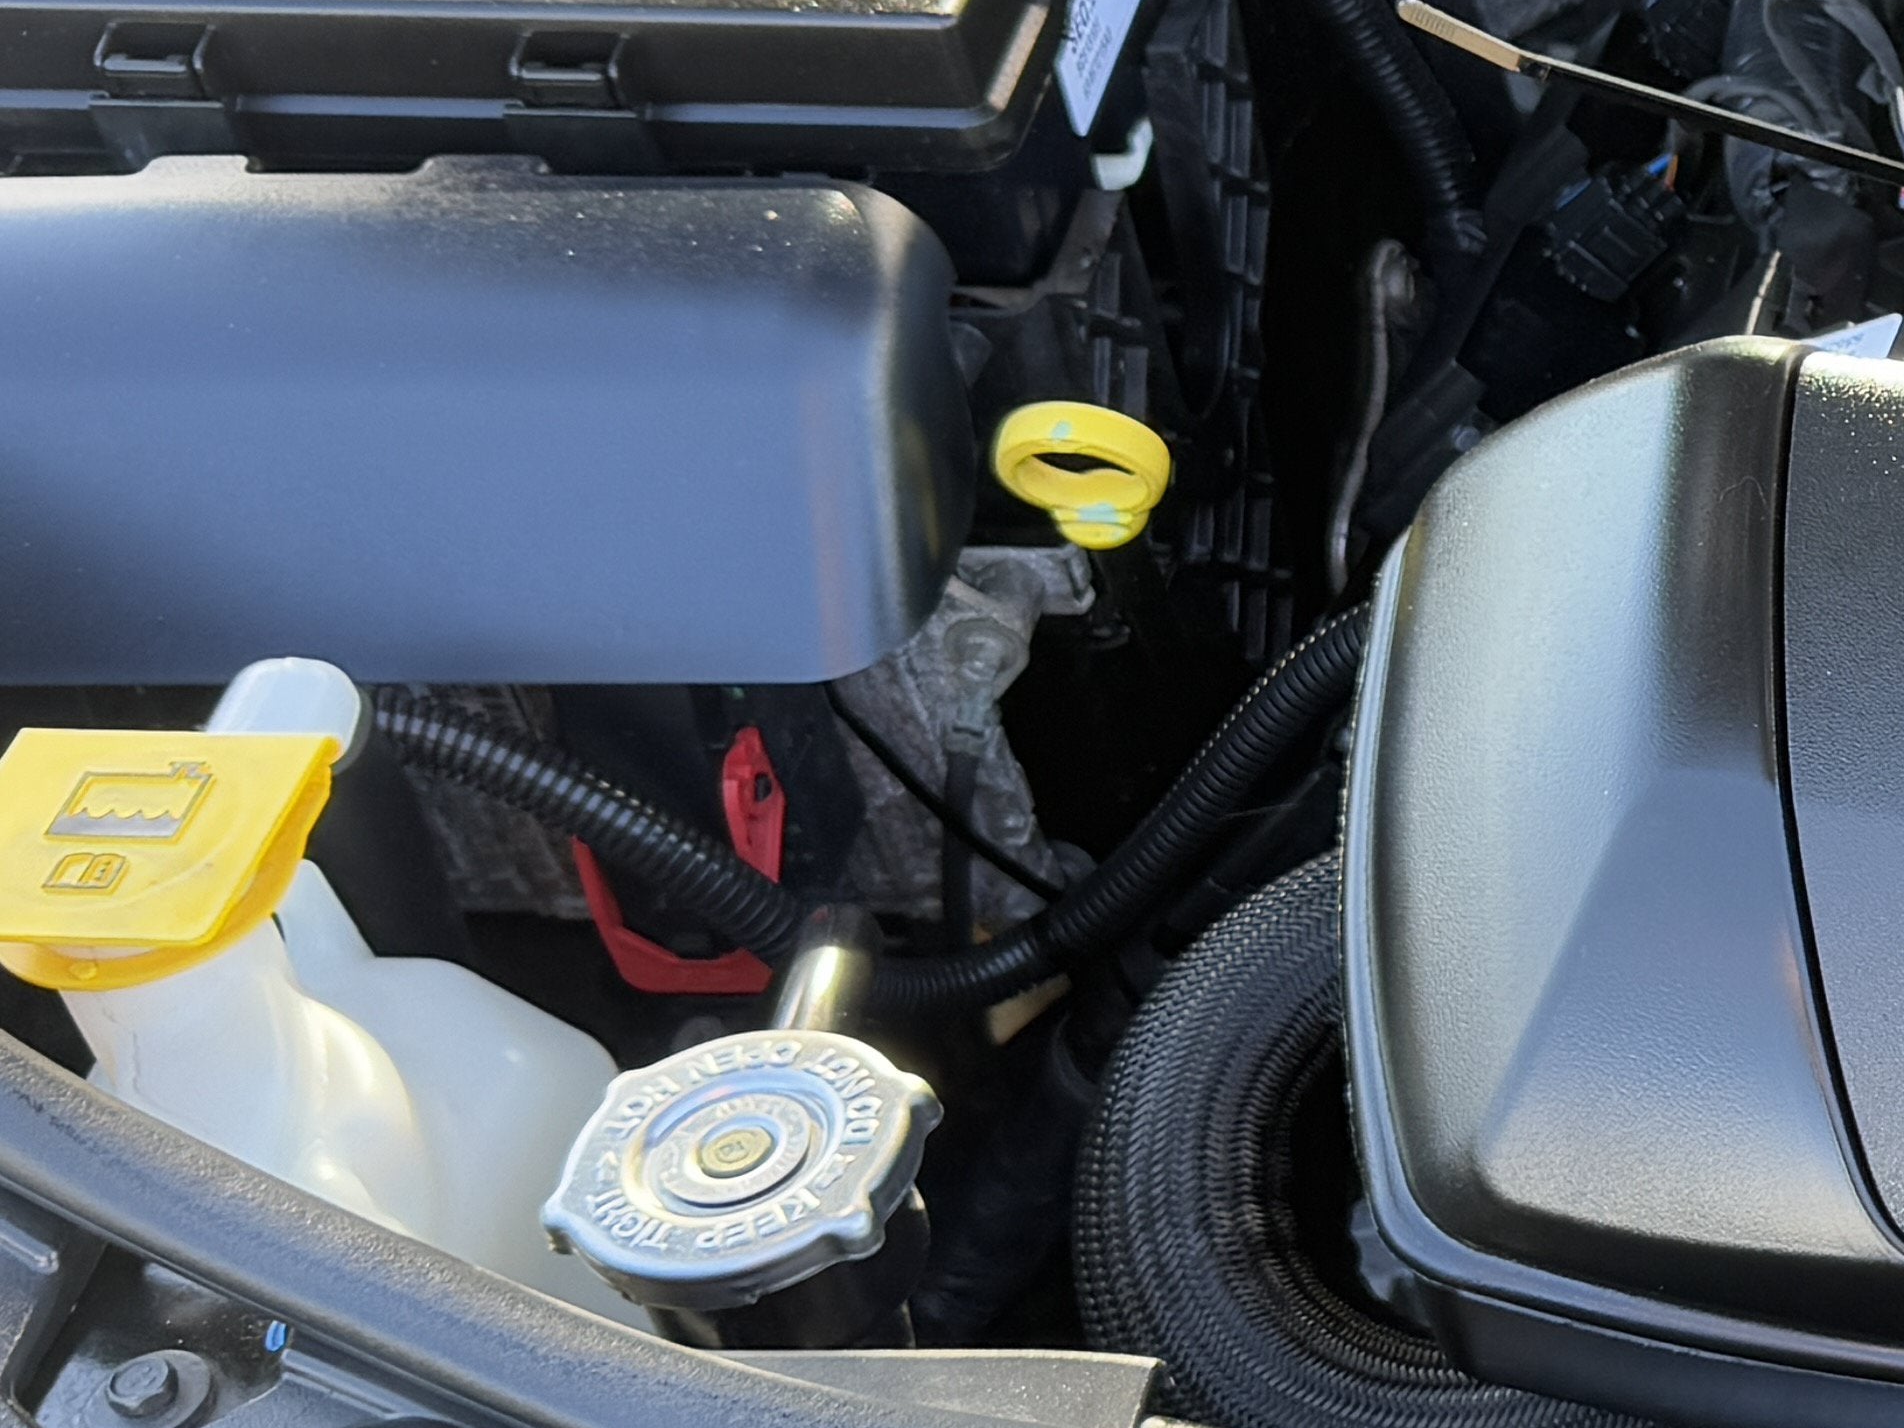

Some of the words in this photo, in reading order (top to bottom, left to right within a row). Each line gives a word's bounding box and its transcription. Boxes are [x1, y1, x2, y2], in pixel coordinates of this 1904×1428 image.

[690, 1039, 804, 1086] OPEN
[607, 1075, 683, 1140] HOT
[586, 1191, 672, 1253] TIGHT
[697, 1189, 822, 1253] KEEP
